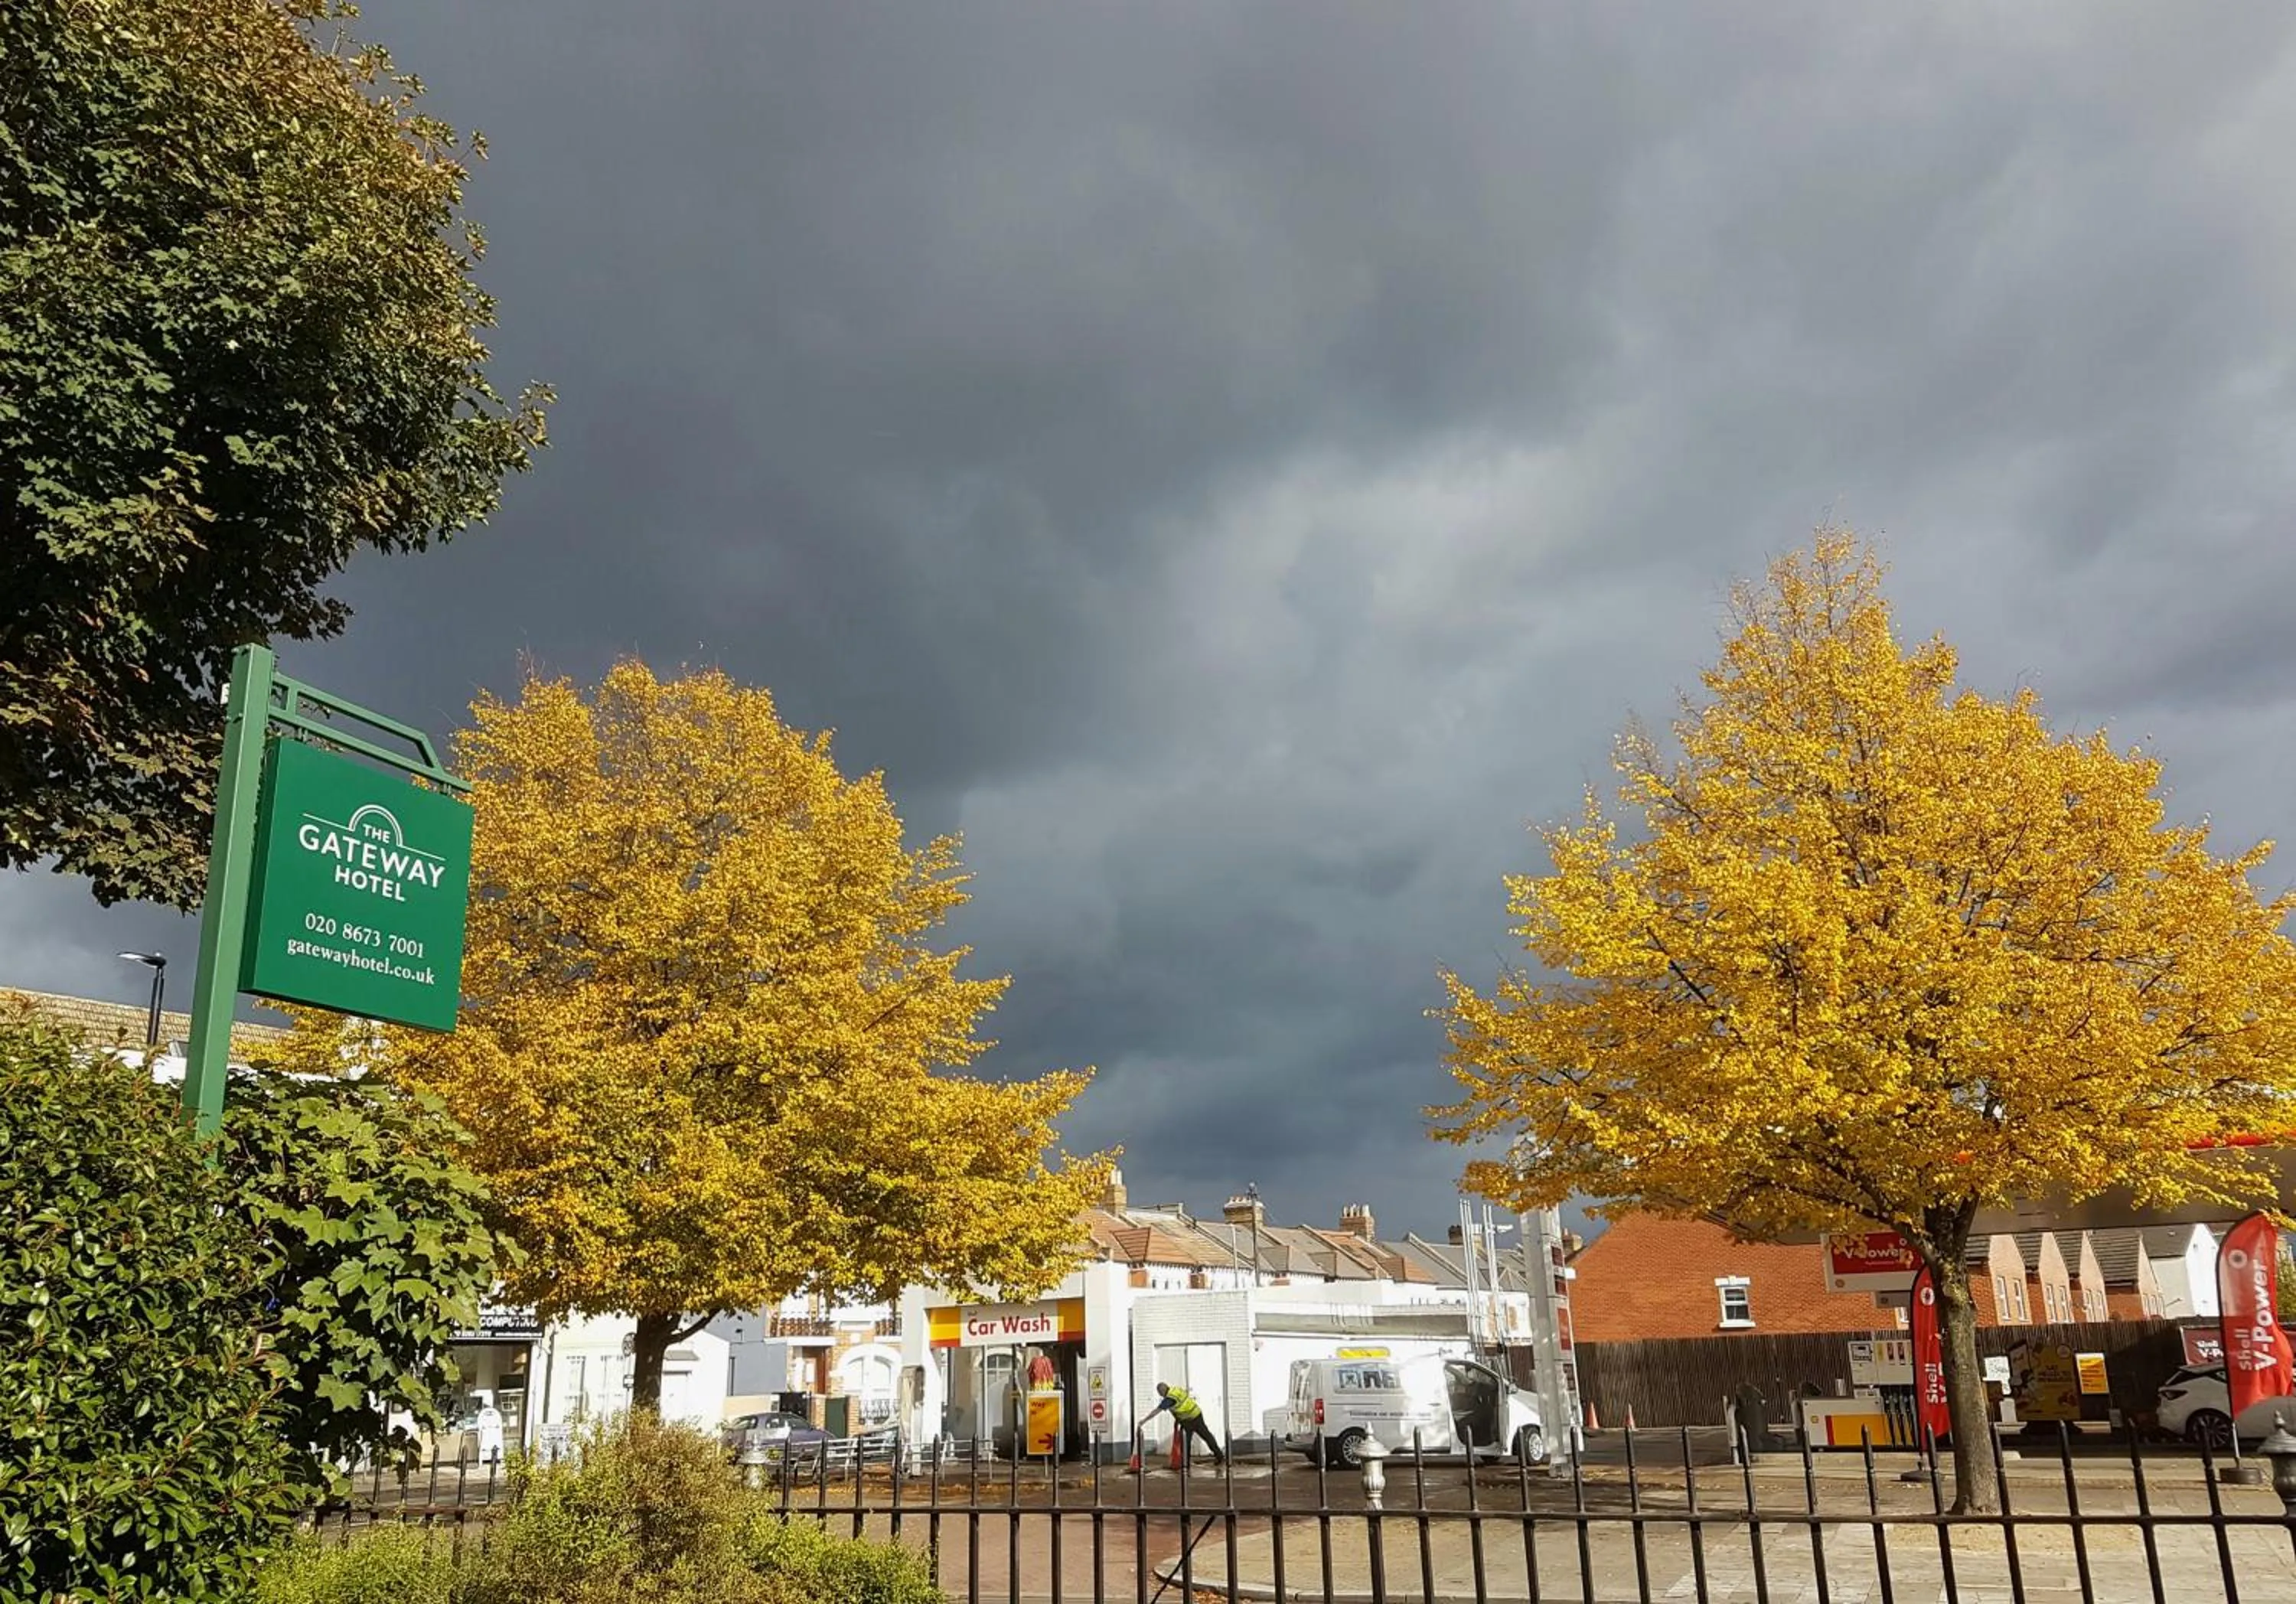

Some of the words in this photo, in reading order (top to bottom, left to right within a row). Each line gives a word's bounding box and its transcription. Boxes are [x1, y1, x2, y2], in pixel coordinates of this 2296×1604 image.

[363, 823, 390, 843] THE
[299, 824, 445, 888] GATEWAY
[335, 865, 406, 901] HOTEL
[305, 913, 337, 935] 020
[342, 923, 381, 947] 8673
[388, 934, 423, 958] 7001
[287, 939, 435, 985] gatewayhotel.co.uk
[968, 1318, 996, 1335] Car
[1002, 1312, 1050, 1333] Wash
[2252, 1259, 2278, 1371] V-Power
[2234, 1328, 2252, 1371] Shell
[1925, 1363, 1939, 1404] Shell
